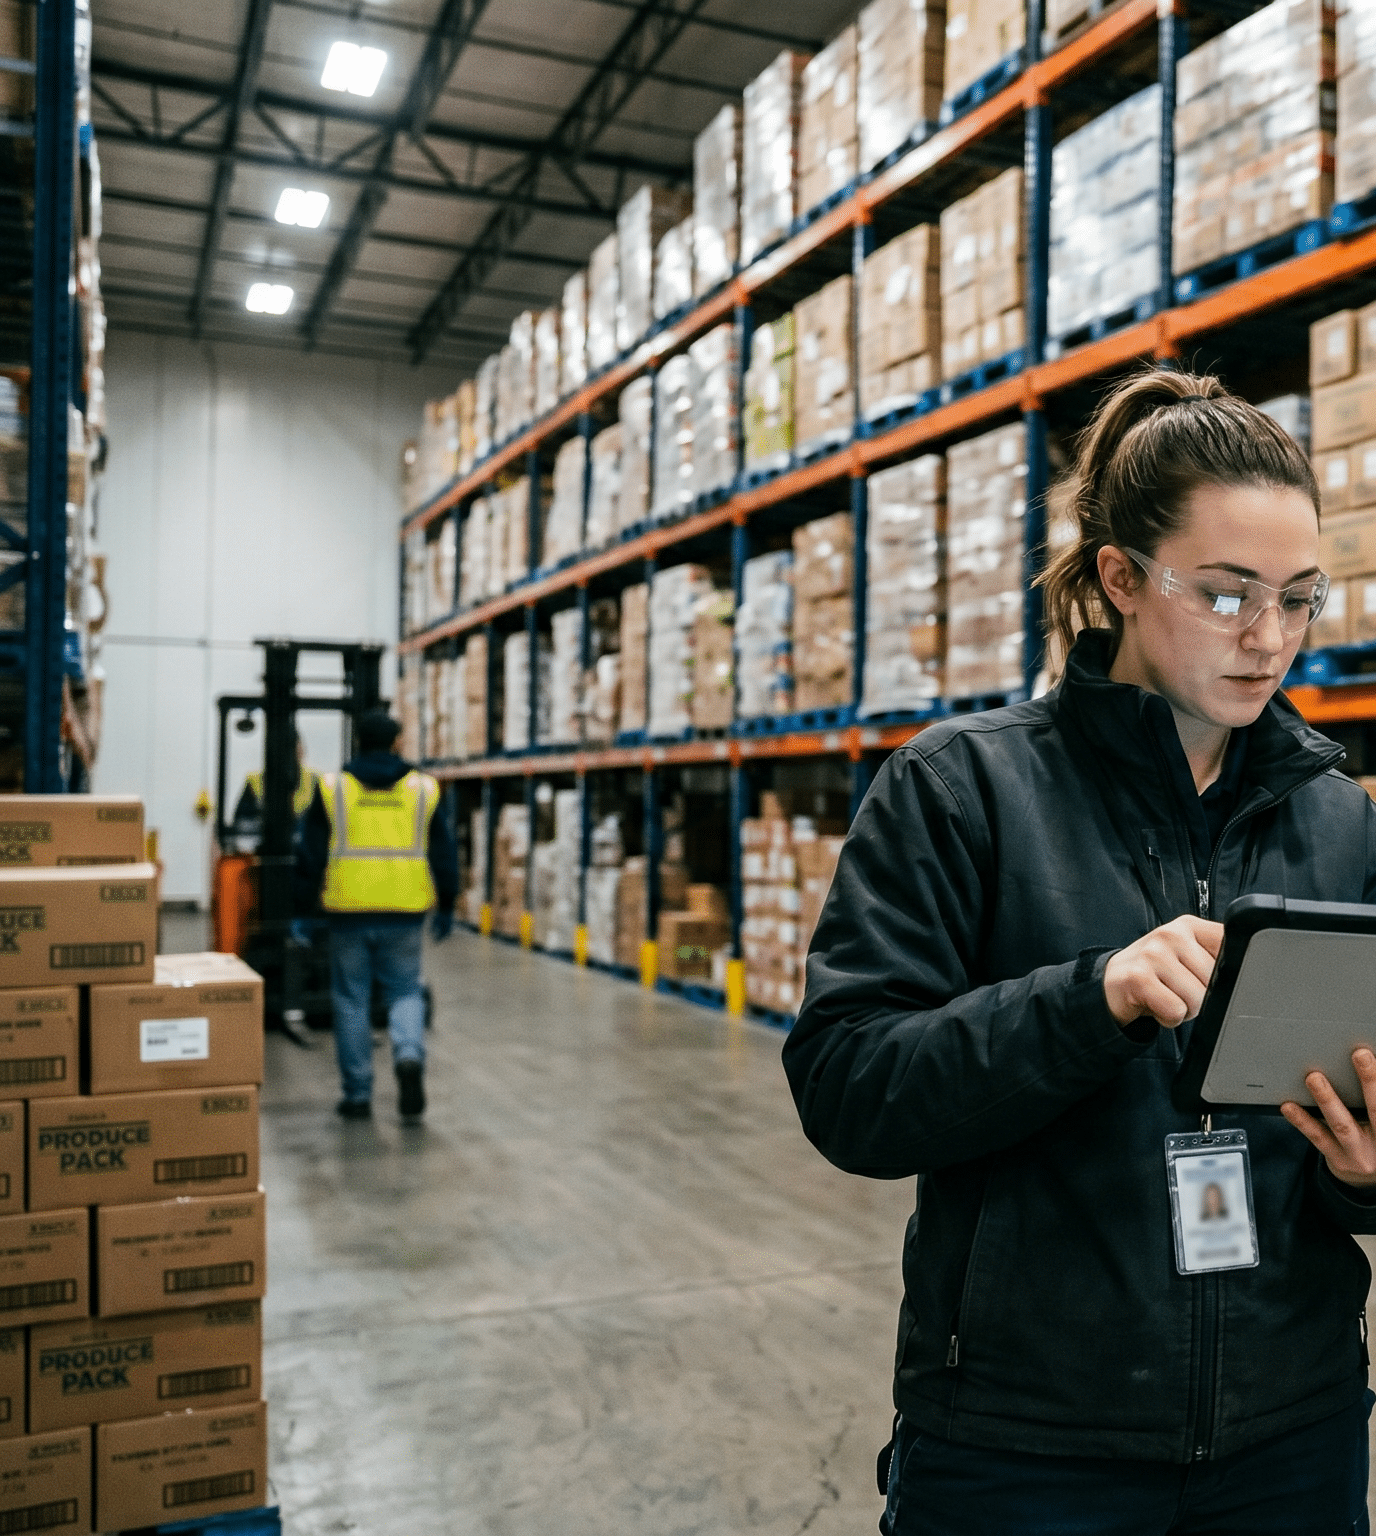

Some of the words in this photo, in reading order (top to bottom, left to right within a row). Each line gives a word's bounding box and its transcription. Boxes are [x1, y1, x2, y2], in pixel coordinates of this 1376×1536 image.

[38, 1127, 150, 1151] PRODUCE
[60, 1150, 125, 1170] PACK
[40, 1344, 153, 1372] PRODUCE
[62, 1367, 128, 1393] PACK
